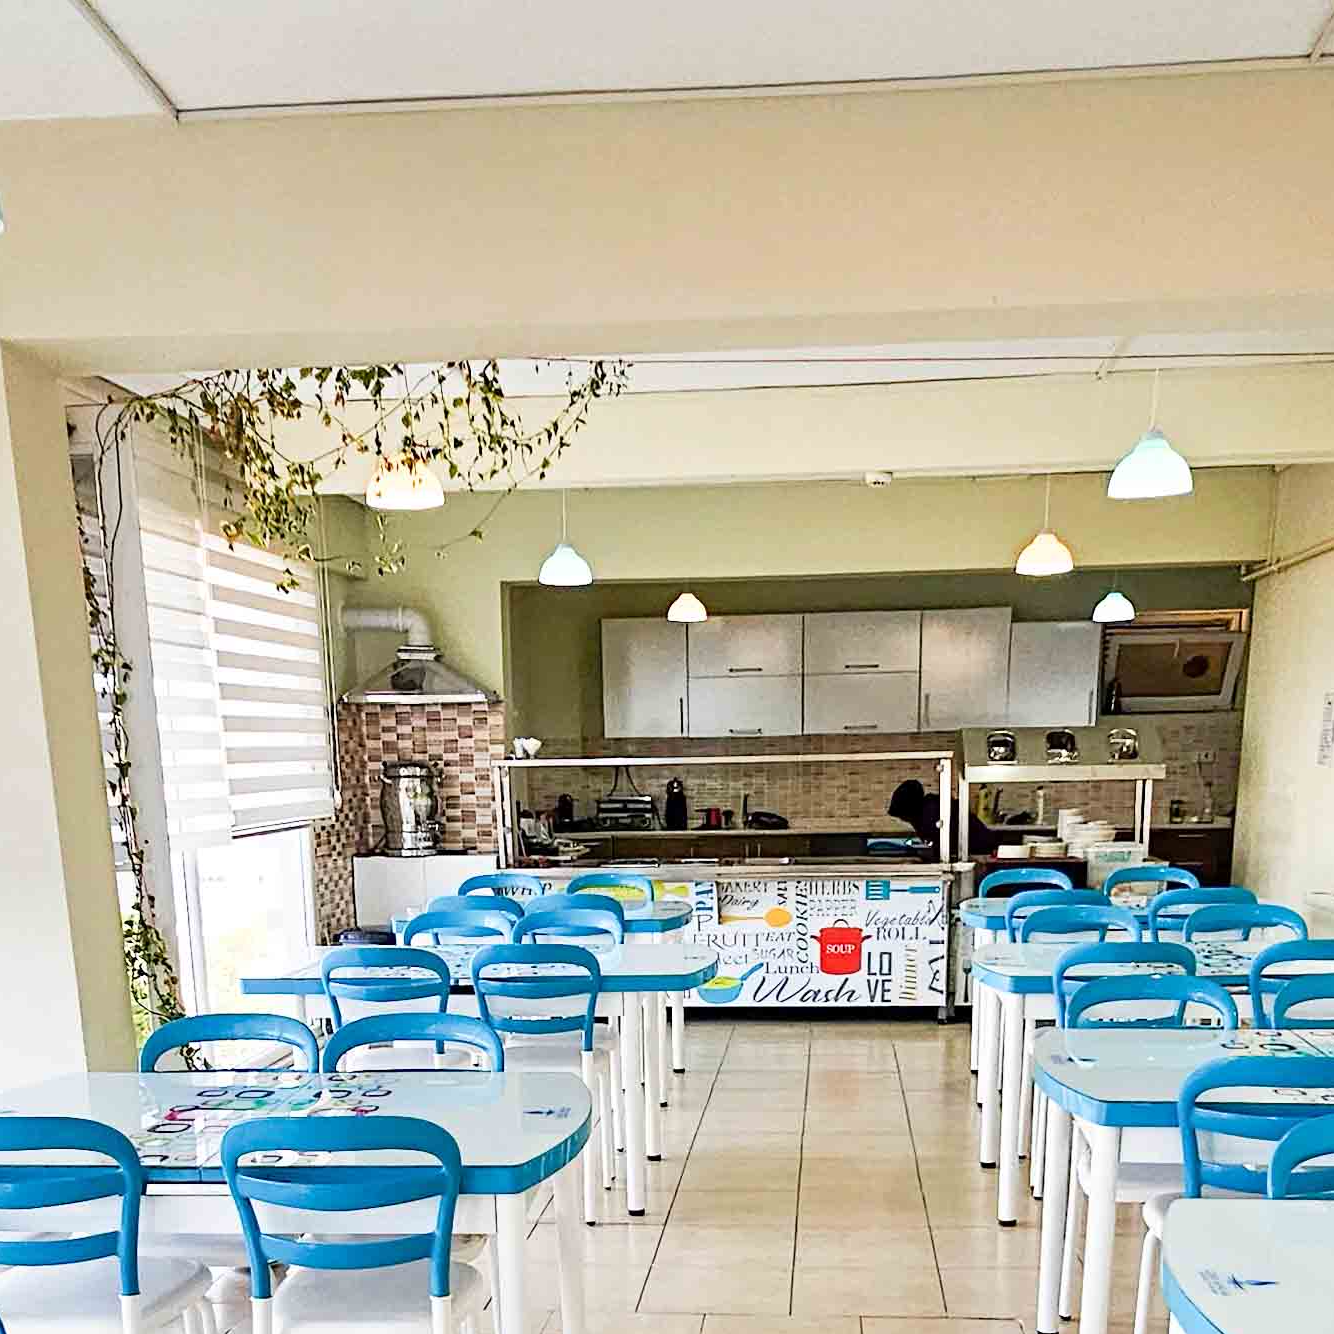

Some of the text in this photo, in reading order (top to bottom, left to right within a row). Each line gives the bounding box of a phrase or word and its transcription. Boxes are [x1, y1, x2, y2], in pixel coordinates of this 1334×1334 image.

[876, 926, 928, 941] ROLL
[753, 948, 794, 960] SUGAR
[826, 944, 855, 955] SOUP
[765, 962, 819, 974] Lunch
[753, 976, 860, 1003] Wash
